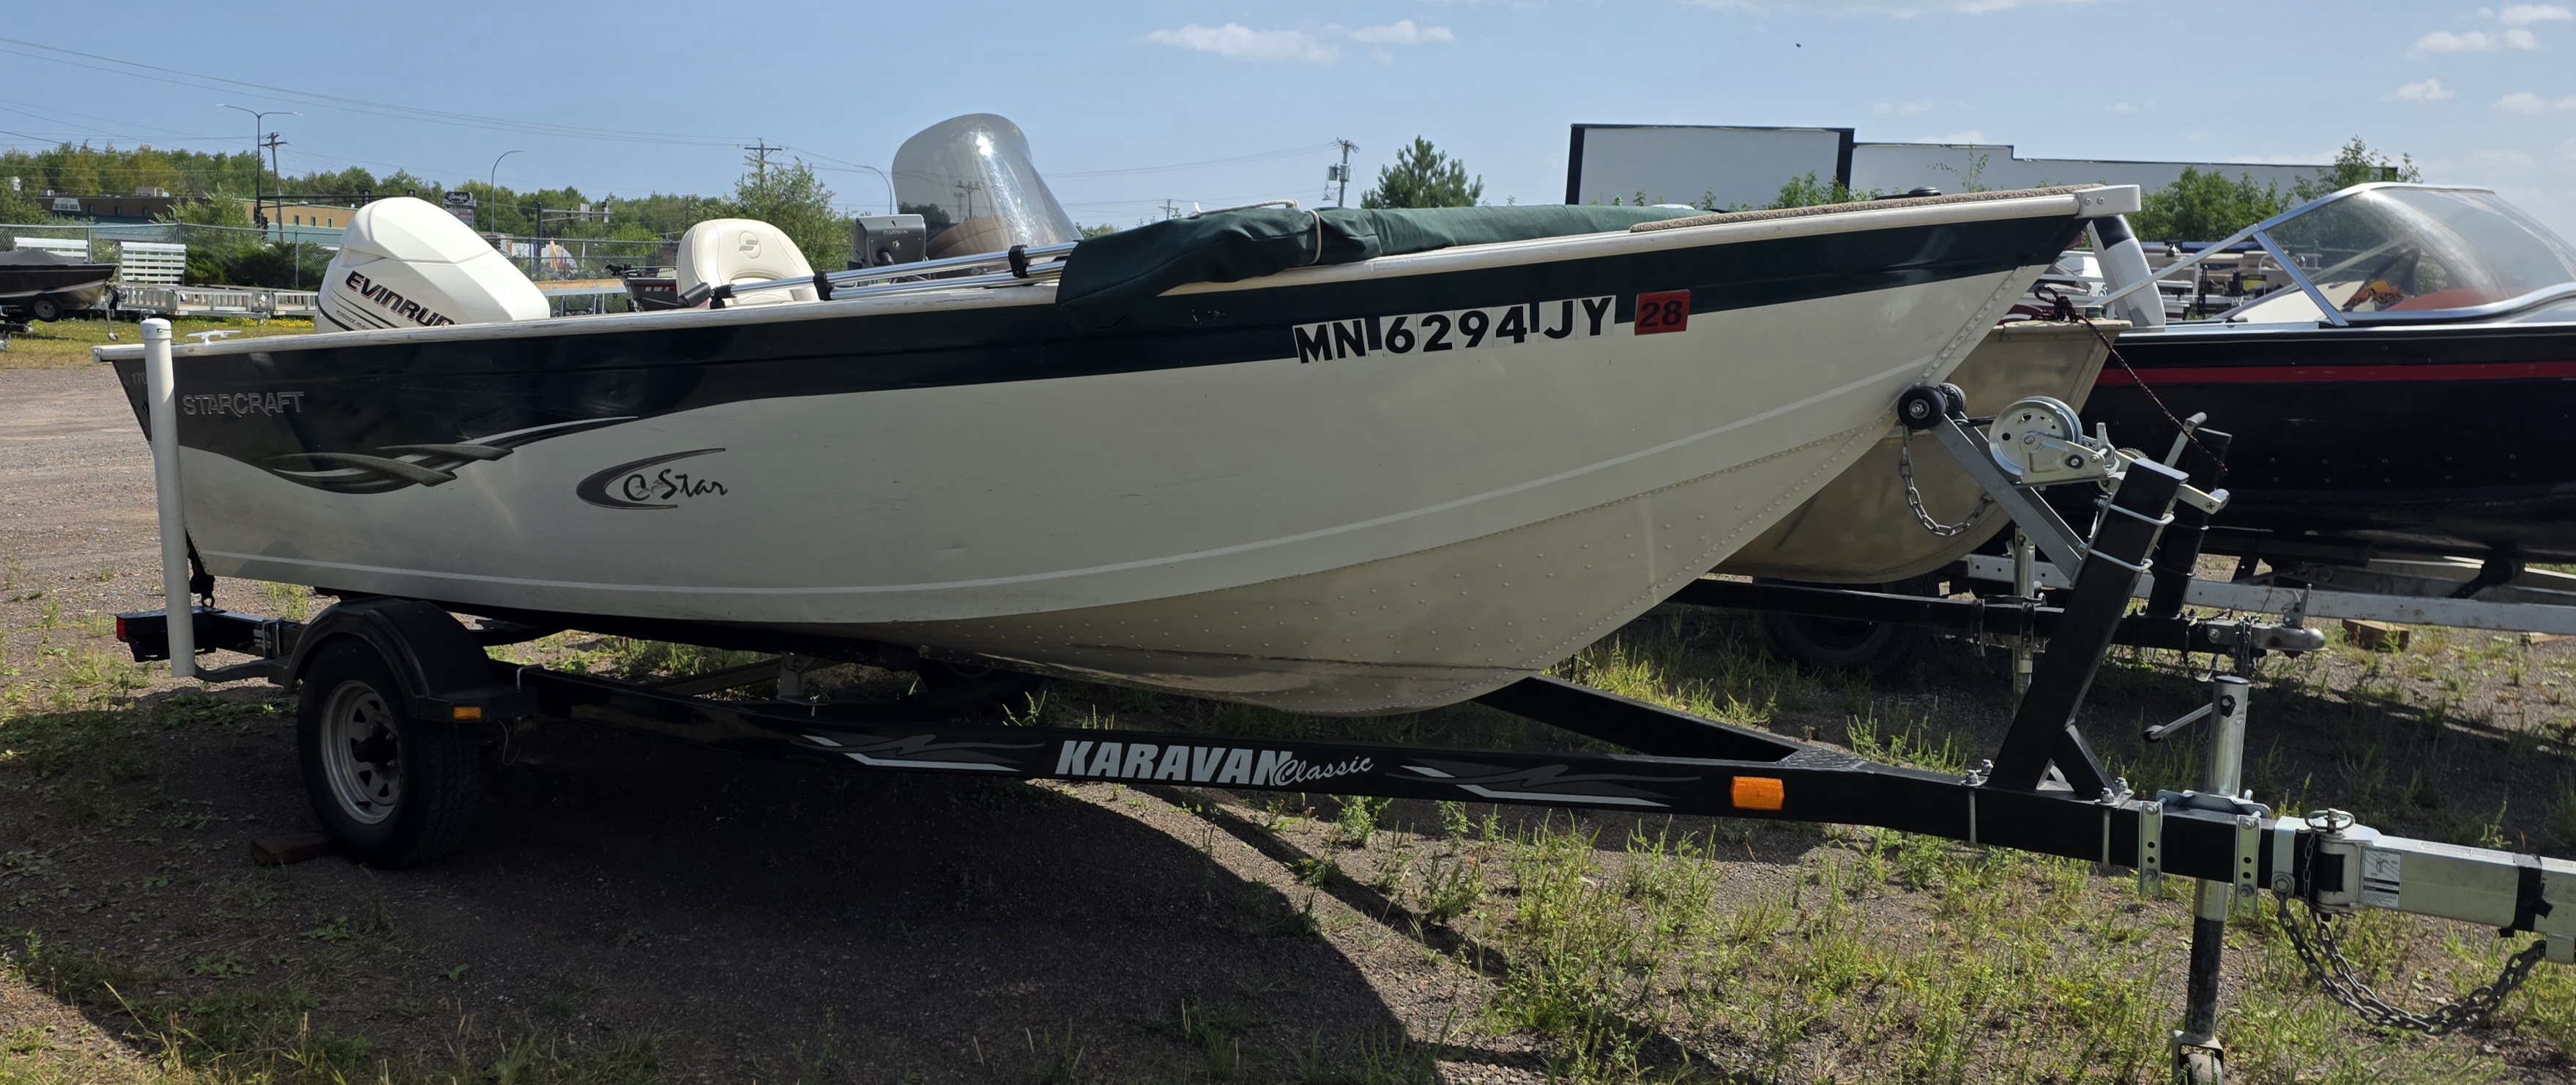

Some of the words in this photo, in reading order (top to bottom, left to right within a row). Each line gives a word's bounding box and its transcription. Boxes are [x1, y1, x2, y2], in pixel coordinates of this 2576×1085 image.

[346, 270, 461, 327] EVINRUD
[1638, 300, 1683, 328] 28
[1295, 320, 1367, 364] MN
[1385, 305, 1527, 354] 6294
[1544, 297, 1613, 340] JY
[183, 391, 305, 417] STARCRAFT
[1054, 740, 1293, 786] KARAVAN
[1273, 755, 1374, 786] Classic
